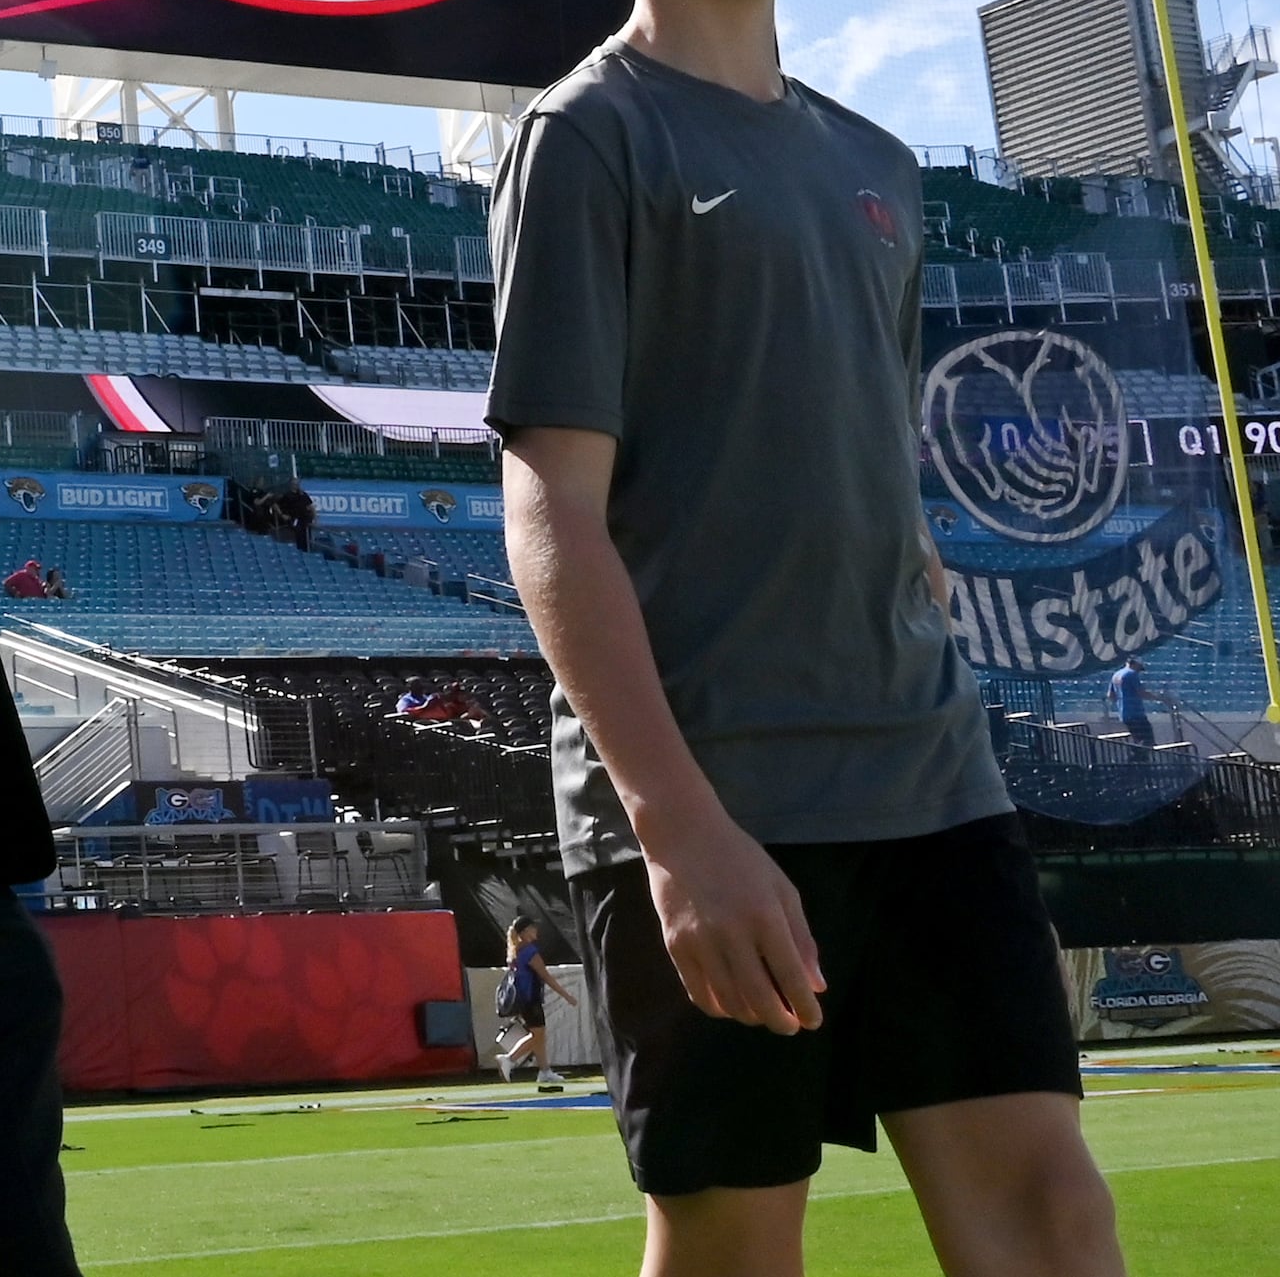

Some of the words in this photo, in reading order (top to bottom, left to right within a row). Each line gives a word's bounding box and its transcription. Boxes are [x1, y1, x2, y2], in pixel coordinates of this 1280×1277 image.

[99, 126, 121, 139] 350
[137, 238, 166, 255] 349
[1169, 282, 1197, 297] 351
[1178, 424, 1222, 456] Q1
[62, 488, 107, 507] BUD
[107, 489, 165, 509] LIGHT
[350, 496, 405, 514] LIGHT
[1090, 995, 1146, 1009] FLORIDA
[1148, 991, 1209, 1006] GEORGIA
